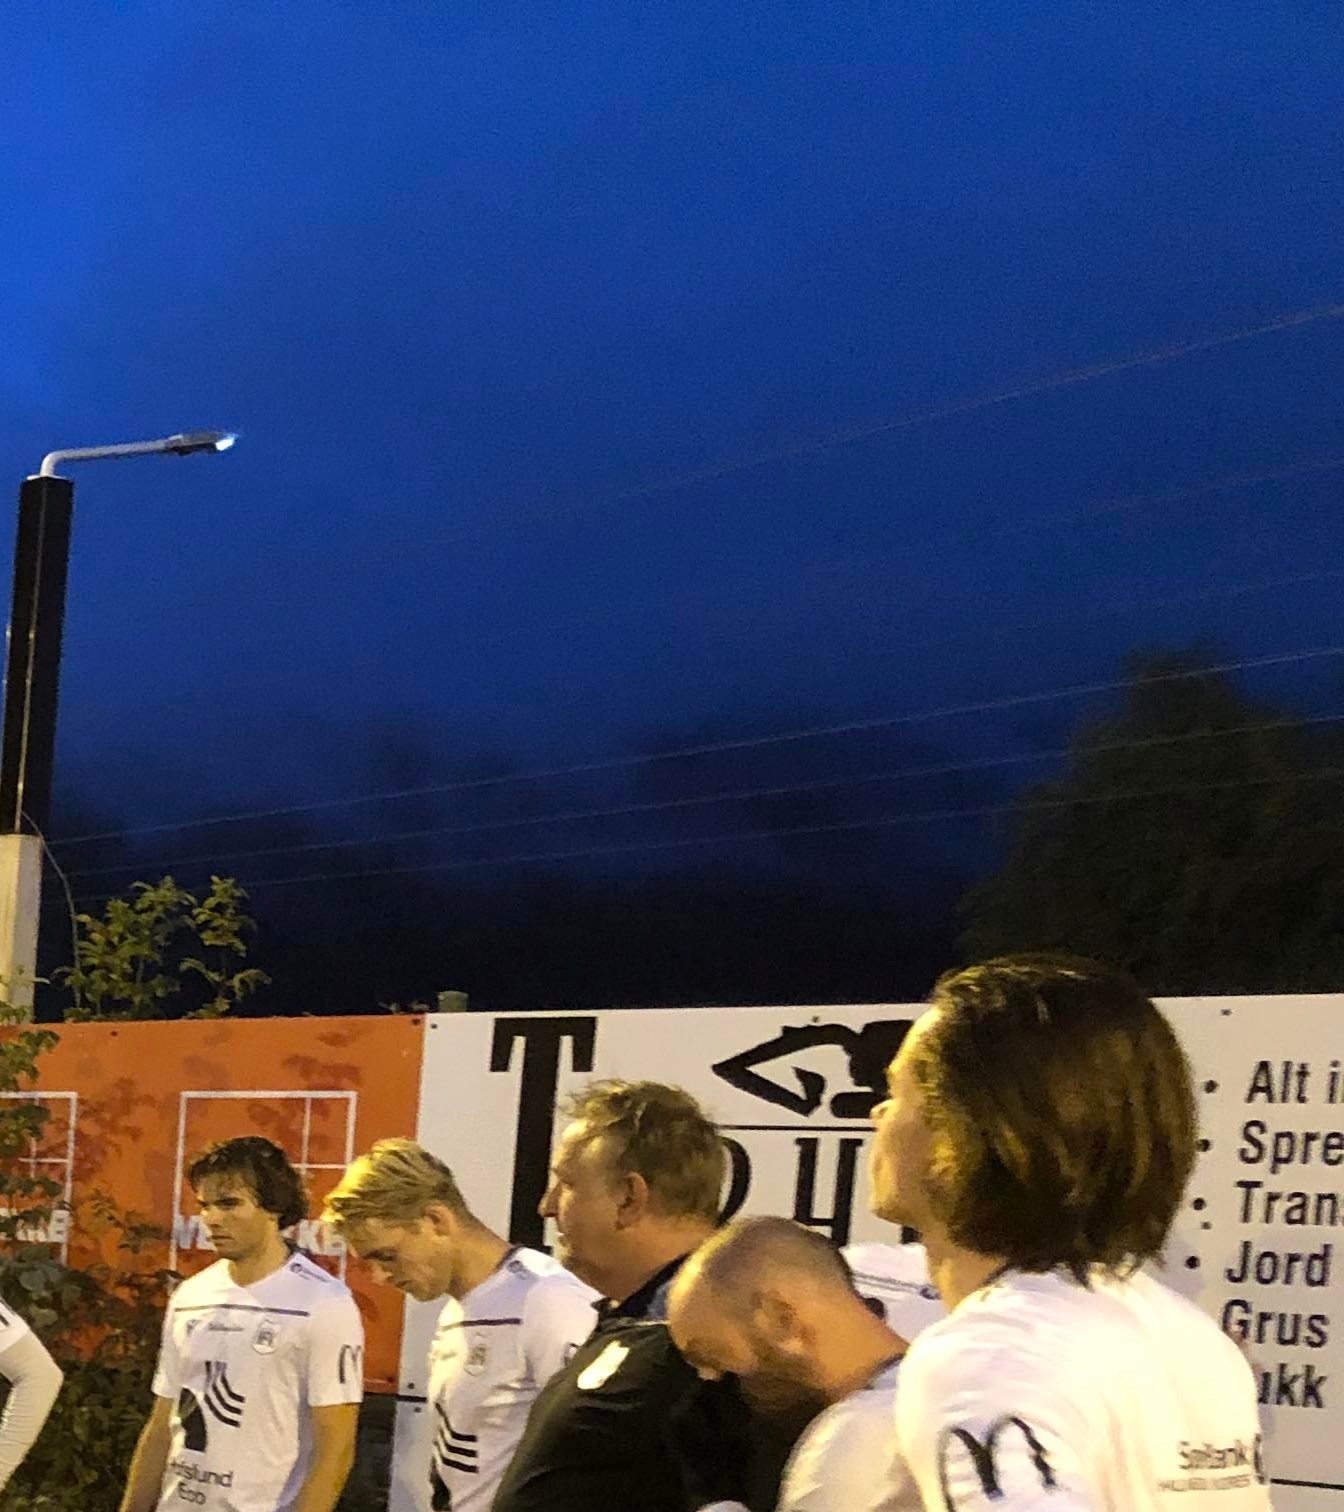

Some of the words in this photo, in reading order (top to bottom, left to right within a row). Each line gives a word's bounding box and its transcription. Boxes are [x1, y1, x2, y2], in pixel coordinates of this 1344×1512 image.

[1244, 1059, 1311, 1105] Alt
[1238, 1119, 1344, 1176] Spre
[1233, 1180, 1344, 1227] Tran
[1224, 1240, 1333, 1288] Jord
[1221, 1299, 1331, 1349] Grus
